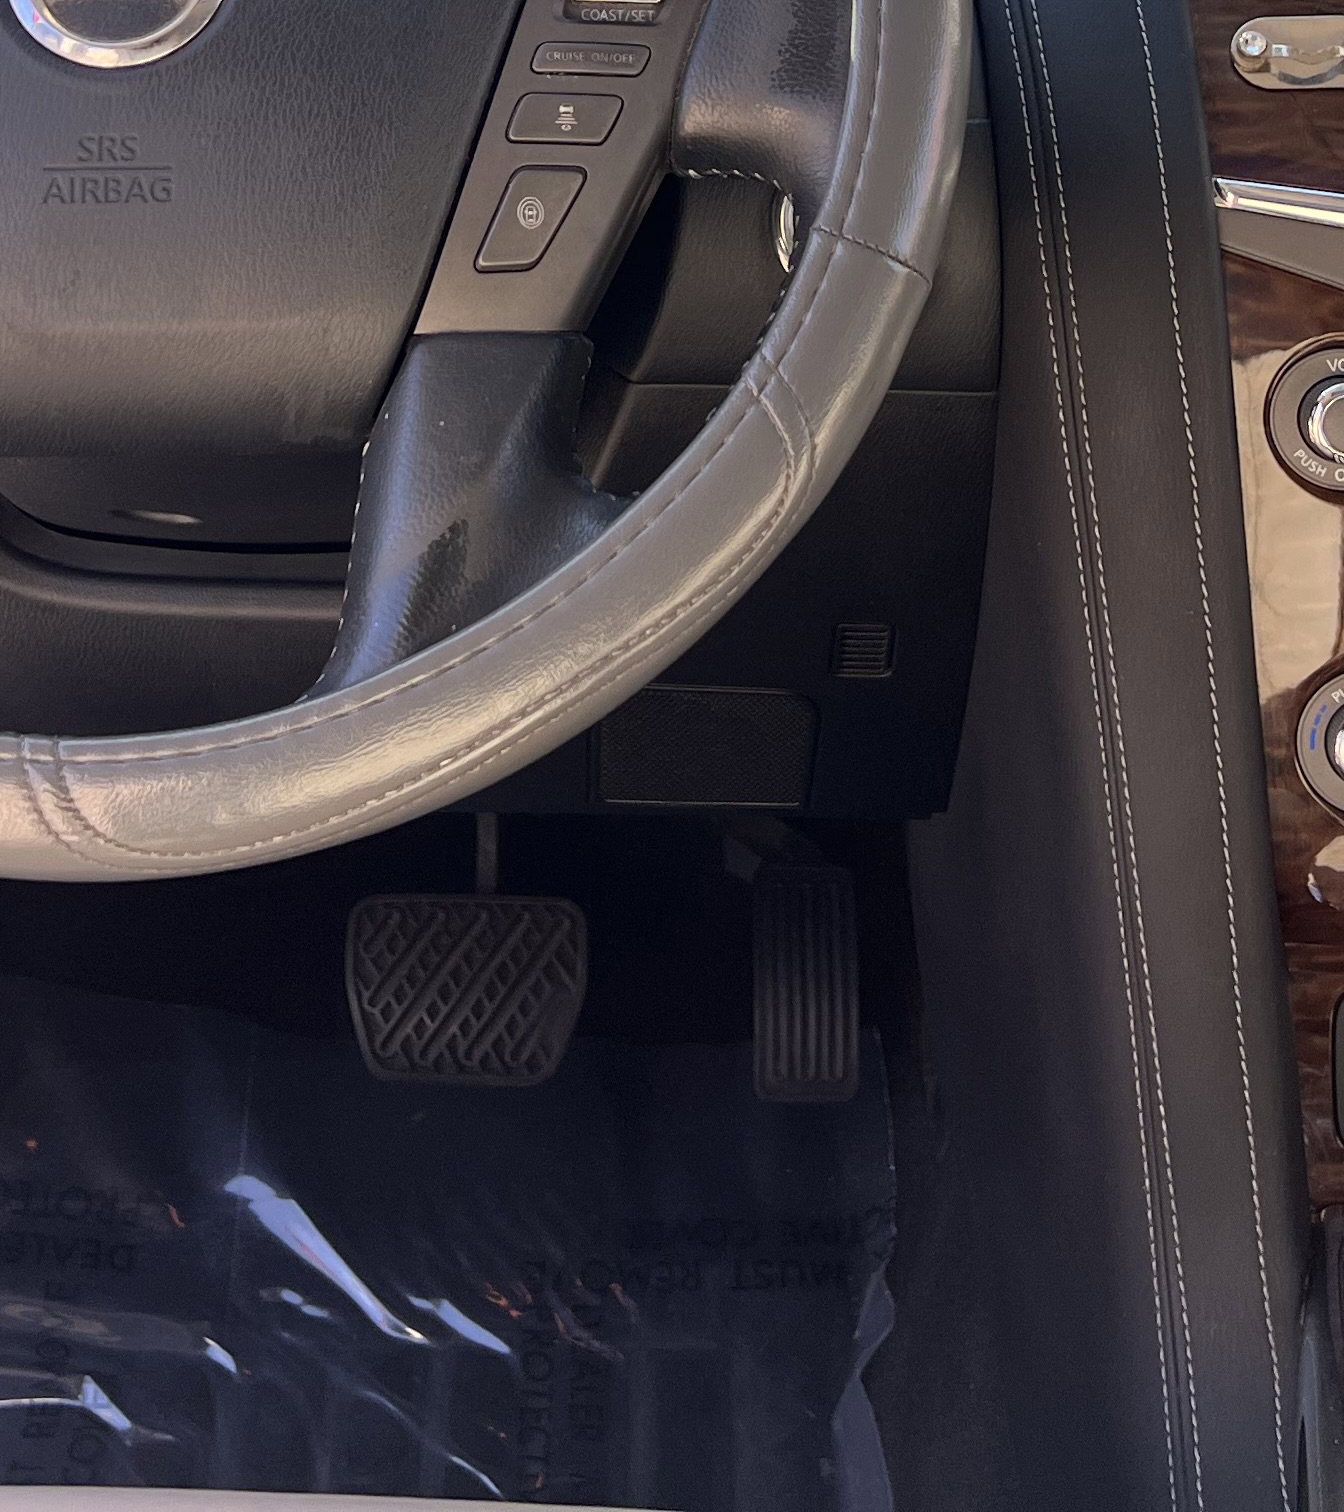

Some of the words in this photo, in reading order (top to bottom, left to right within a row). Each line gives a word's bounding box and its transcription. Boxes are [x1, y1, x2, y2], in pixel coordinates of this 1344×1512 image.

[581, 8, 655, 22] COAST/SET
[76, 134, 139, 163] SRS
[42, 177, 173, 205] AIRBAG
[1294, 446, 1328, 479] PUSH
